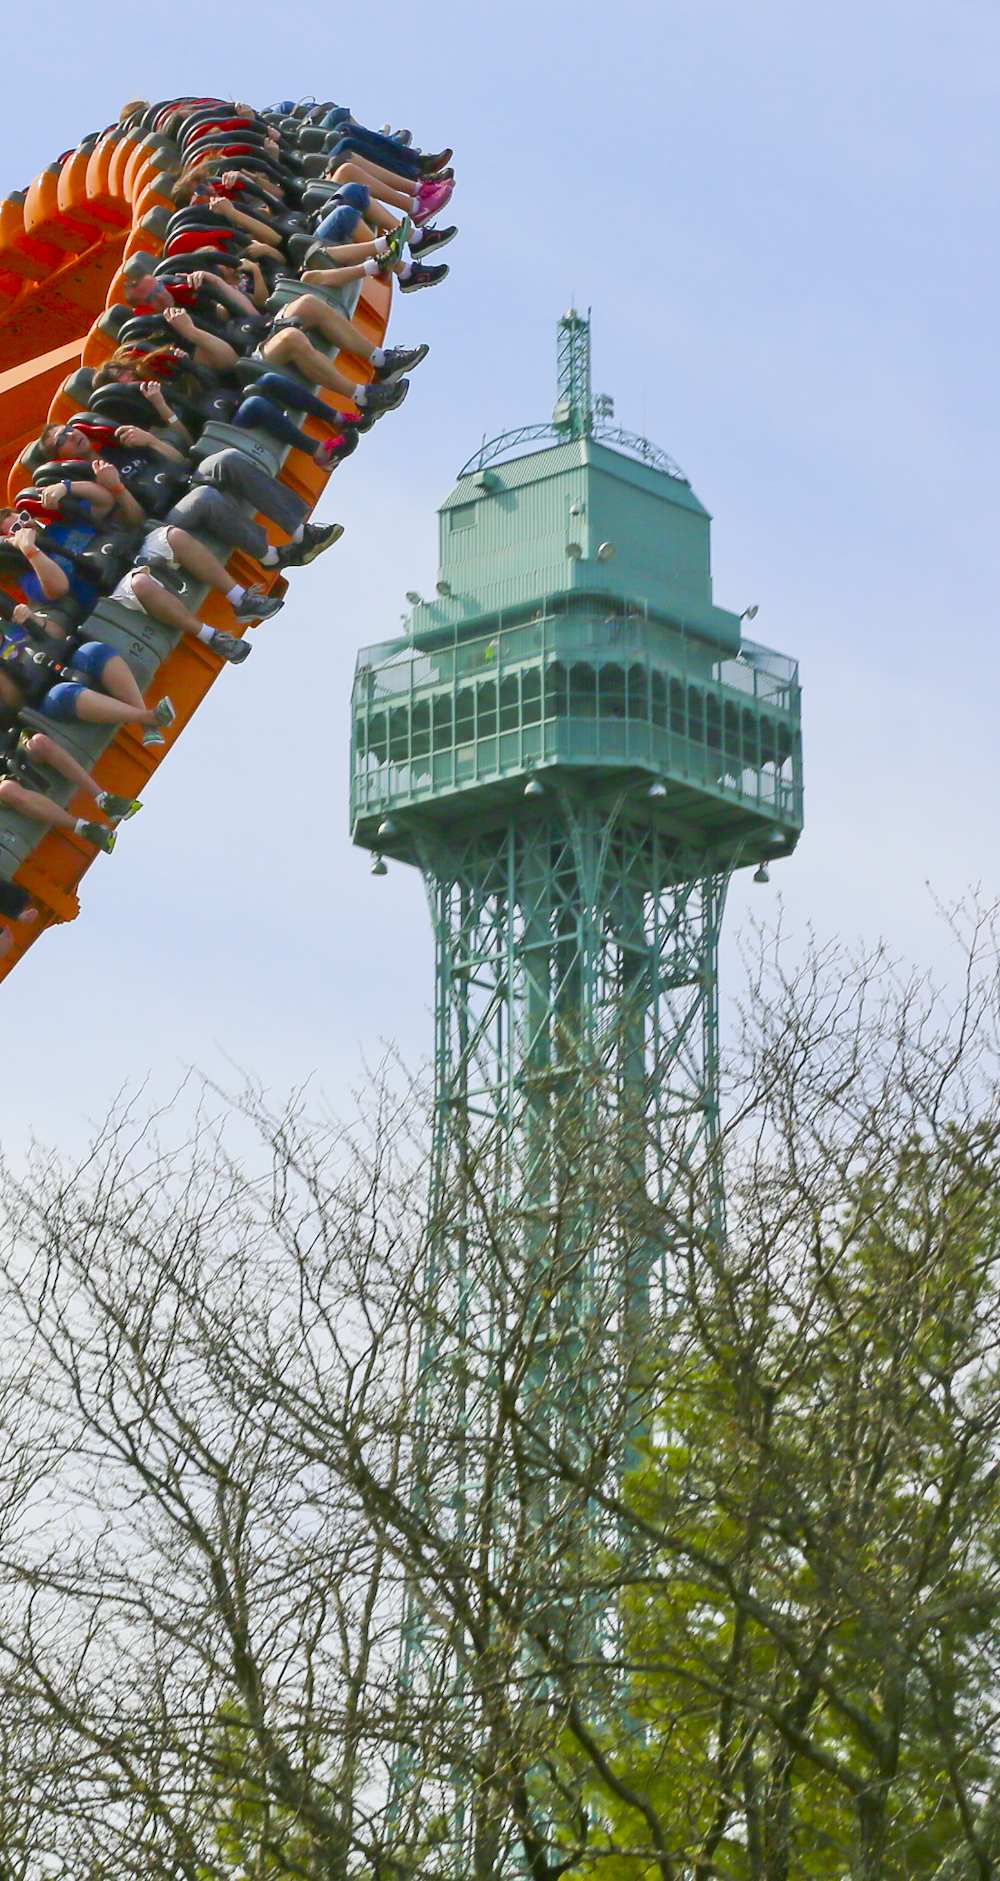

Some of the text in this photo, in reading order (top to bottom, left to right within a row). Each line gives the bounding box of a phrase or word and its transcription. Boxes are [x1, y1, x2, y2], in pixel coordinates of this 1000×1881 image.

[252, 444, 264, 456] 15
[142, 626, 155, 640] 13
[129, 642, 144, 657] 12
